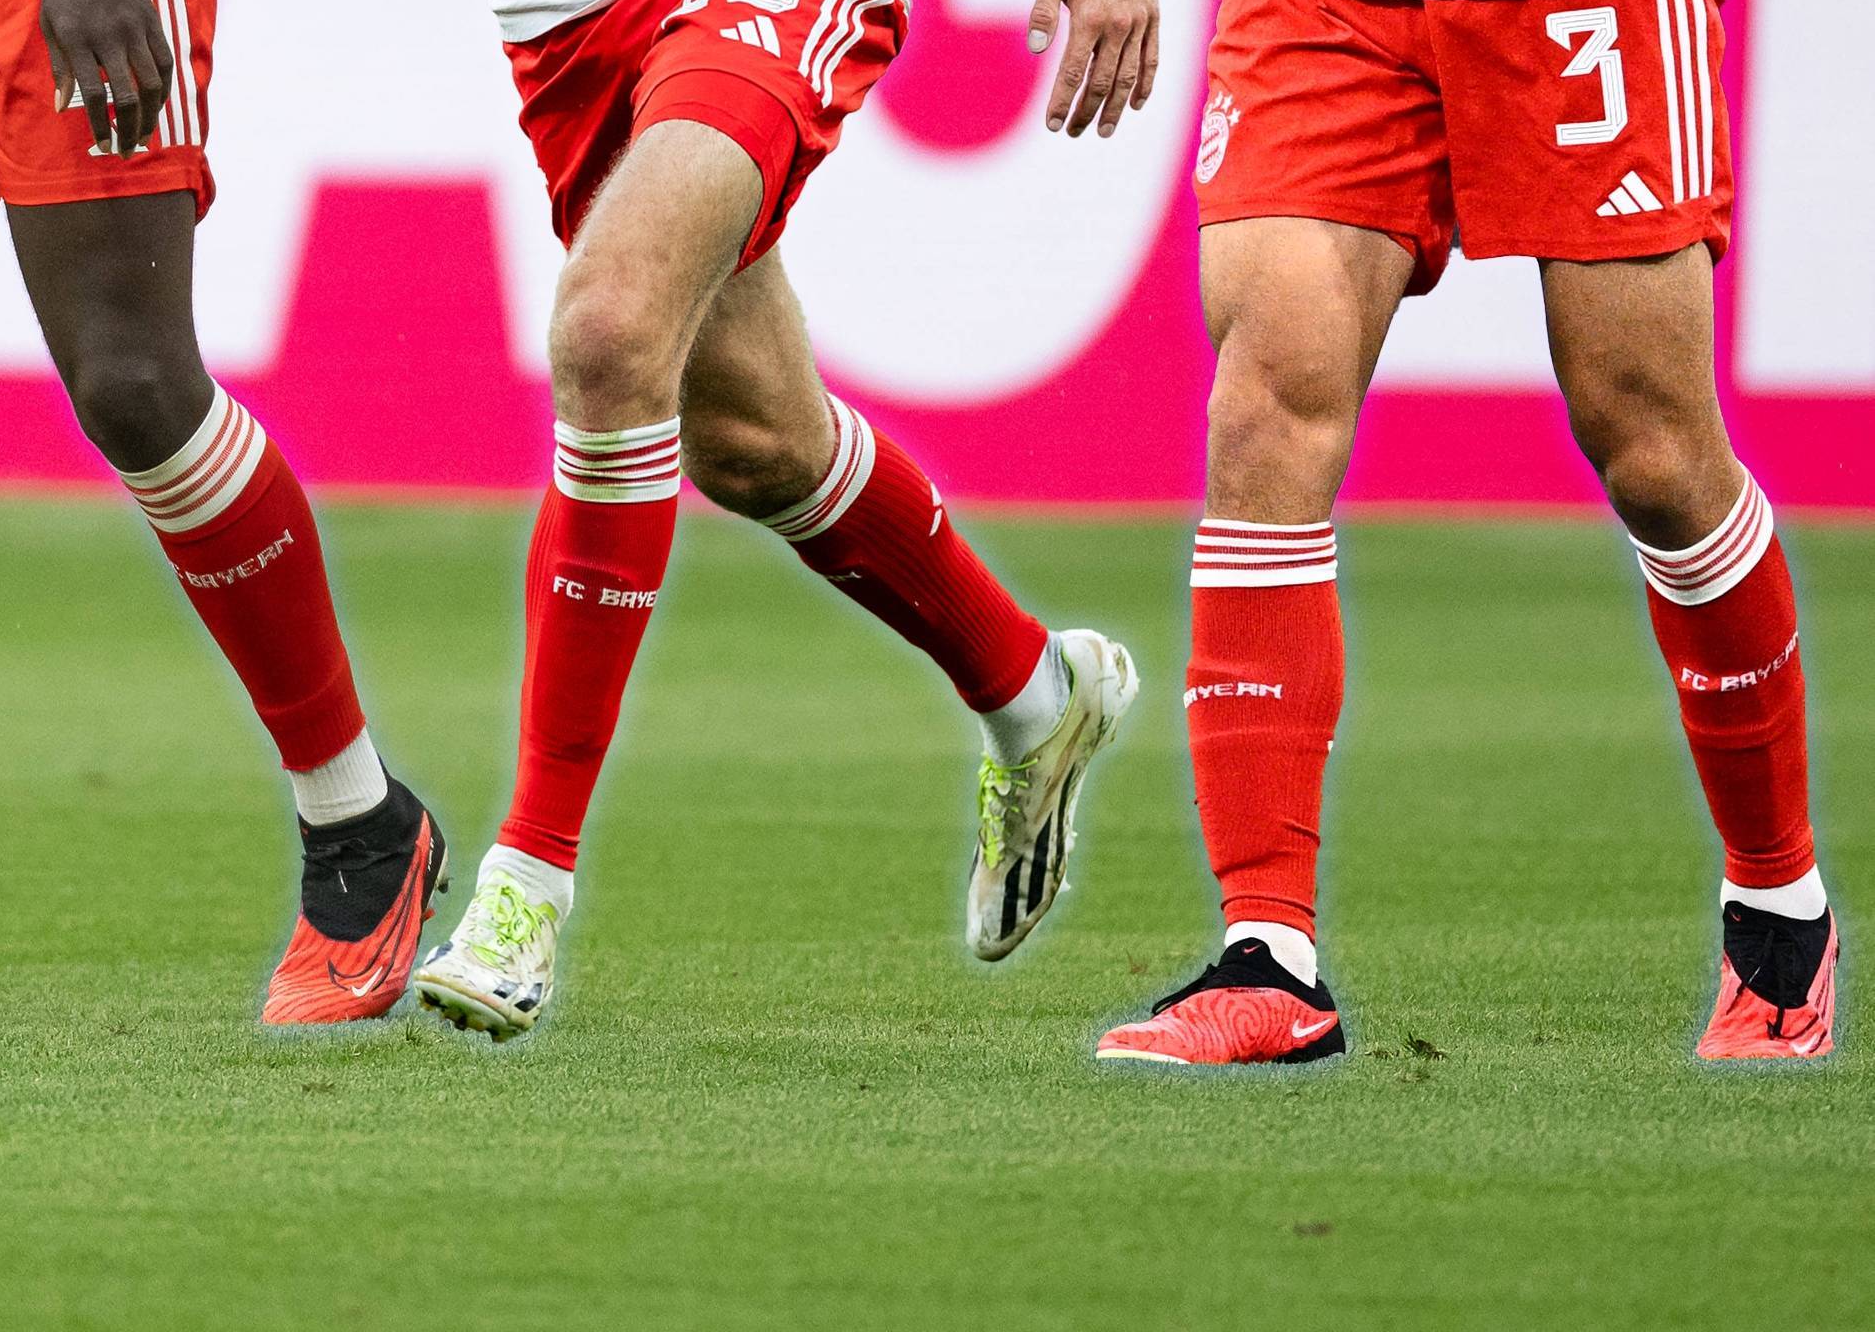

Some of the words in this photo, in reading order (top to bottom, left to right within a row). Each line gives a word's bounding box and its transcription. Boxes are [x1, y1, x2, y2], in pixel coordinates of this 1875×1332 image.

[1545, 6, 1628, 147] 3
[185, 529, 294, 588] BAYERN
[553, 575, 585, 600] FC
[599, 588, 657, 608] BAYE
[1681, 667, 1708, 691] FC
